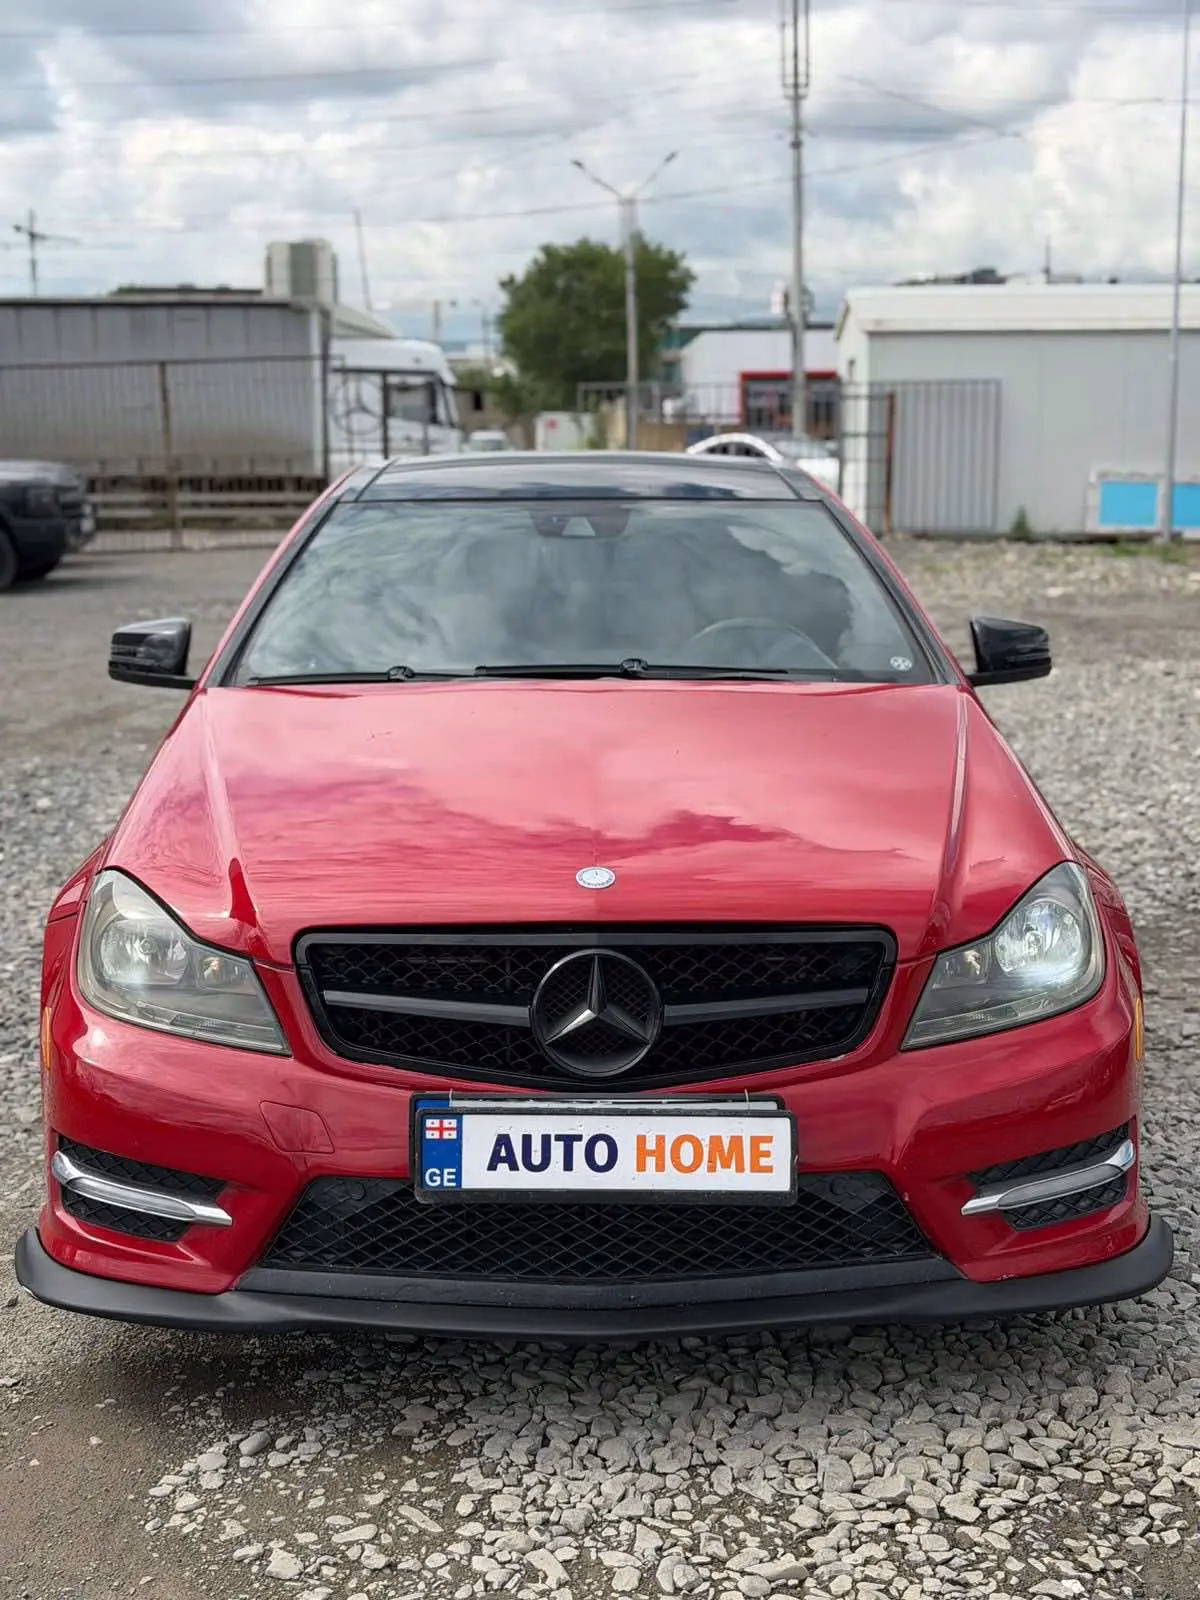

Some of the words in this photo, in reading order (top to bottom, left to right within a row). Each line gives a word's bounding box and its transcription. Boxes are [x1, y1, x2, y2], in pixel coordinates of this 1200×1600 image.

[486, 1133, 619, 1172] AUTO
[636, 1134, 774, 1174] HOME
[424, 1167, 457, 1187] GE
